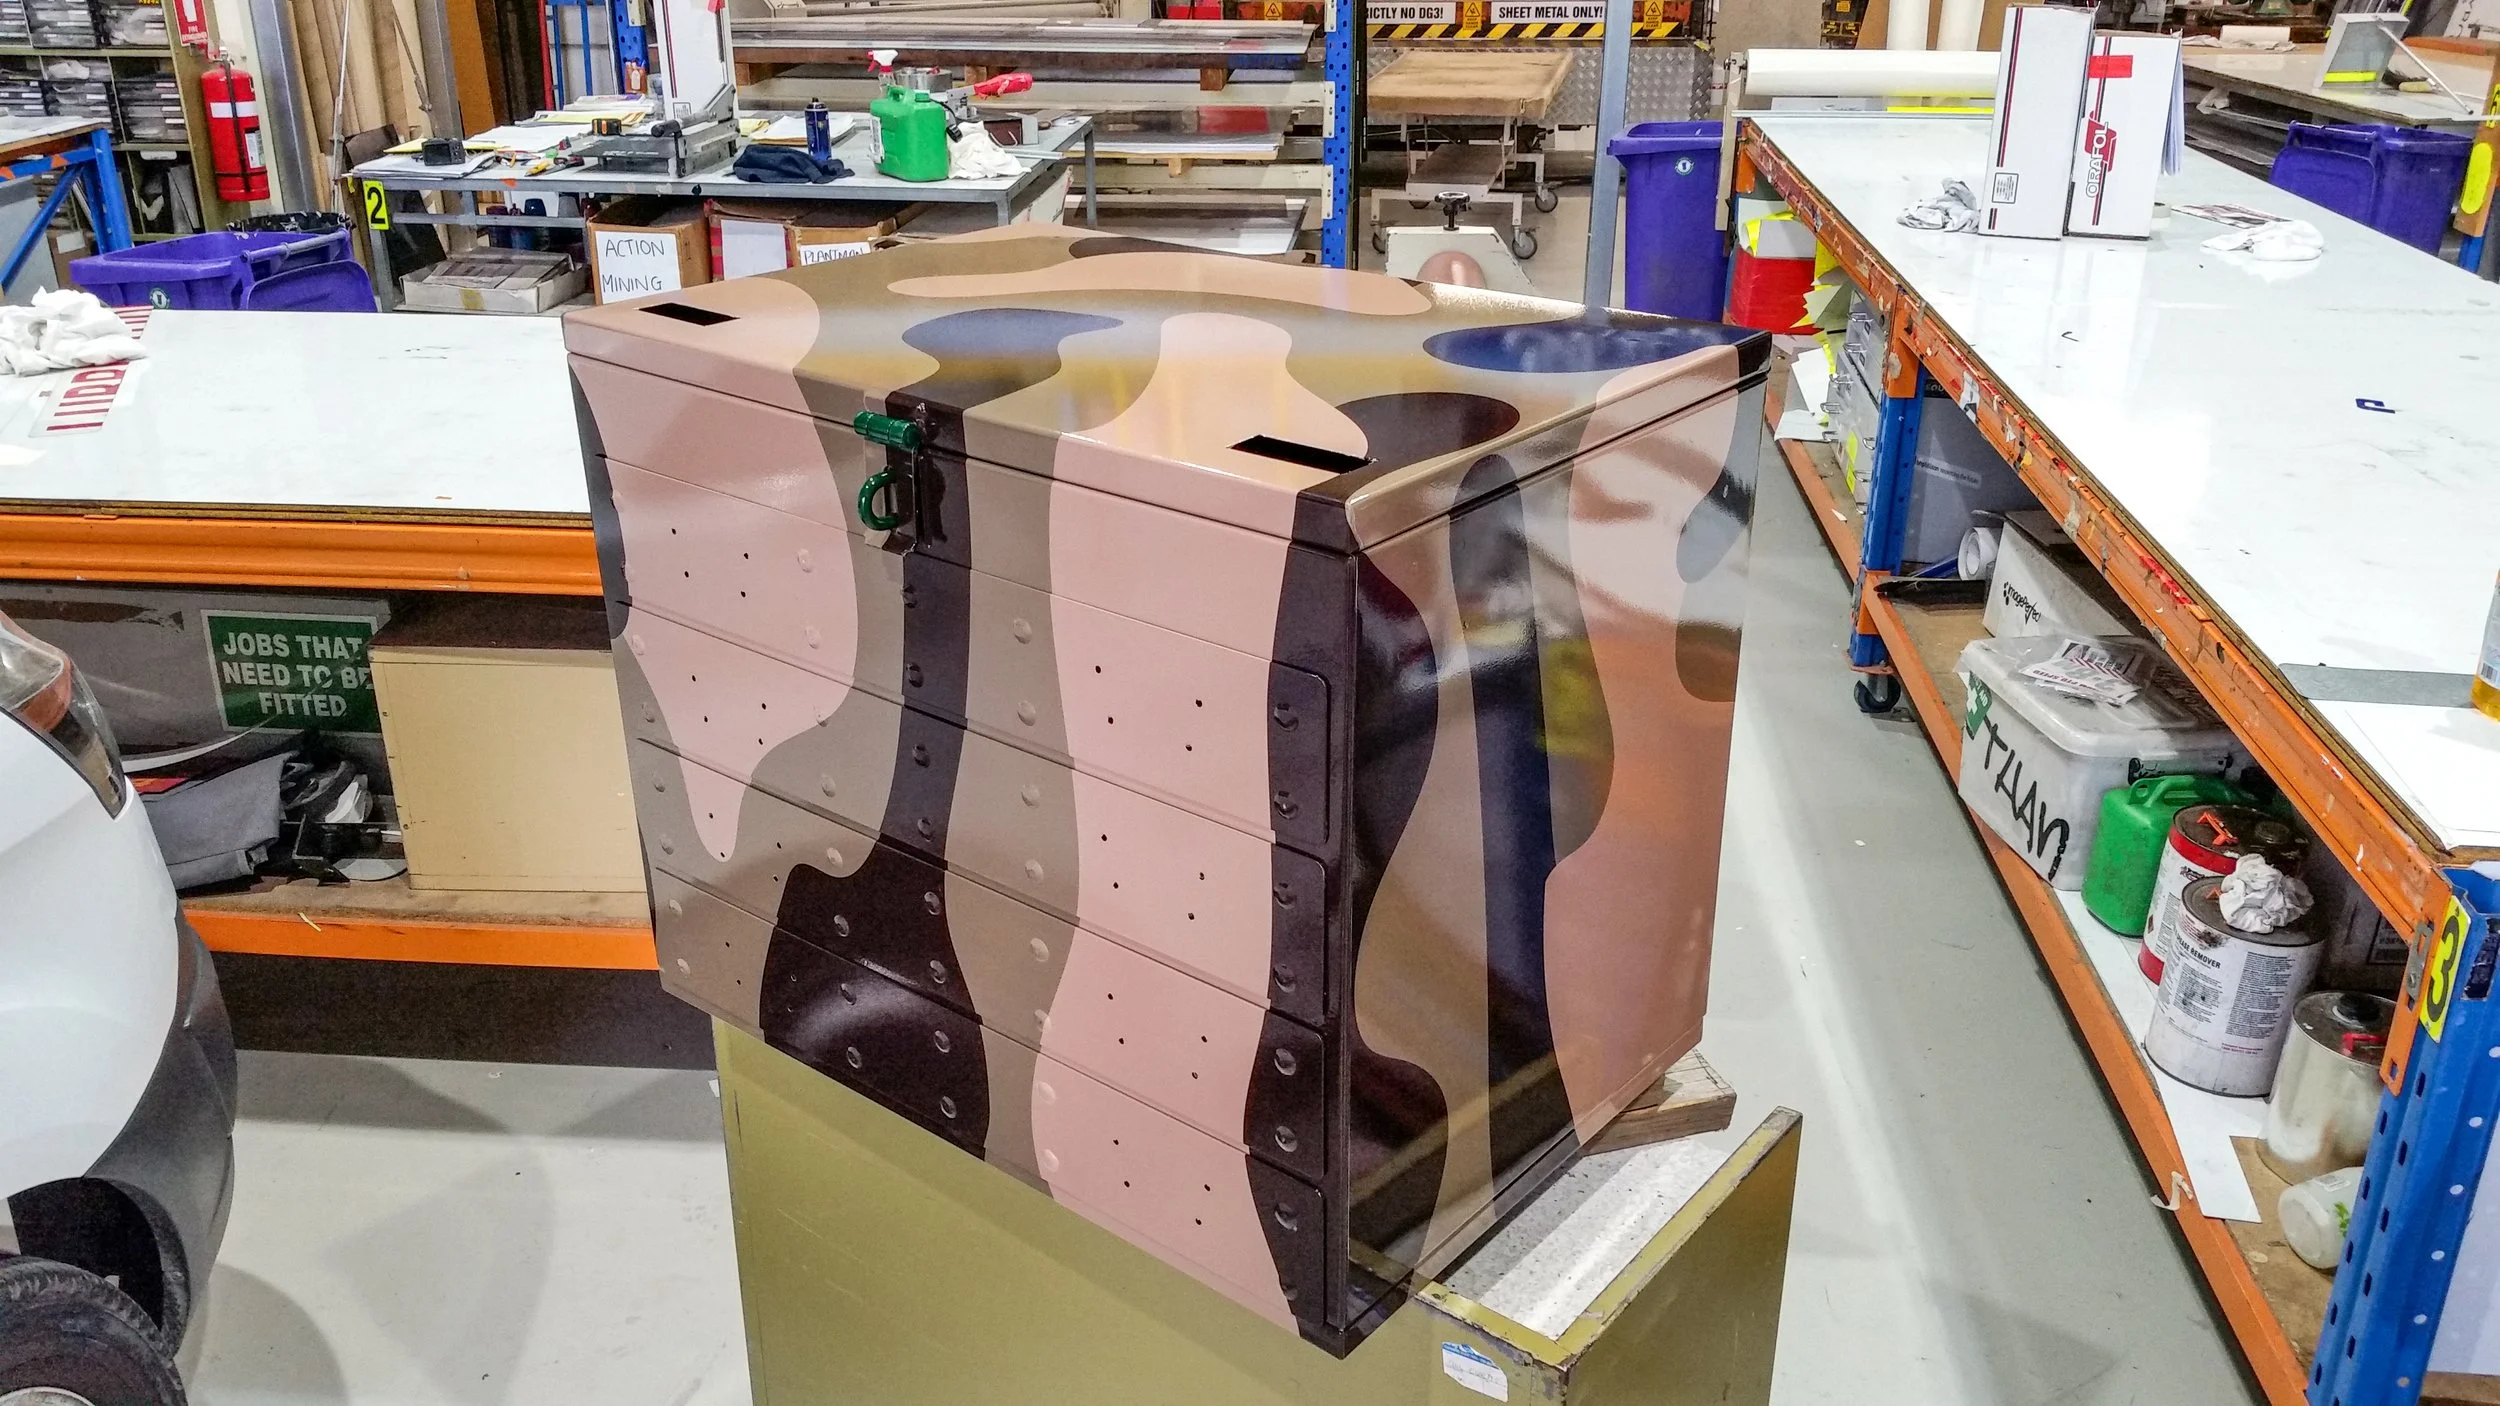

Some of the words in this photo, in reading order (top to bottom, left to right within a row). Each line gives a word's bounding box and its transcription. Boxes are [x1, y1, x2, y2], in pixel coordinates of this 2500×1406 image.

[1400, 7, 1416, 19] NO
[1419, 7, 1444, 19] DG3!
[1498, 6, 1532, 19] SHEET
[1534, 6, 1569, 19] METAL
[1572, 6, 1603, 18] ONLY!
[2086, 121, 2109, 198] ORAFOL
[367, 186, 386, 225] 2
[605, 238, 665, 258] ACTION
[601, 273, 663, 293] MINING
[223, 632, 290, 658] JOBS
[295, 635, 362, 660] THAT
[221, 661, 291, 686] NEED
[296, 665, 333, 689] TO
[258, 692, 347, 717] FITTED
[2190, 947, 2221, 969] REMOVER
[2427, 915, 2460, 1023] 3
